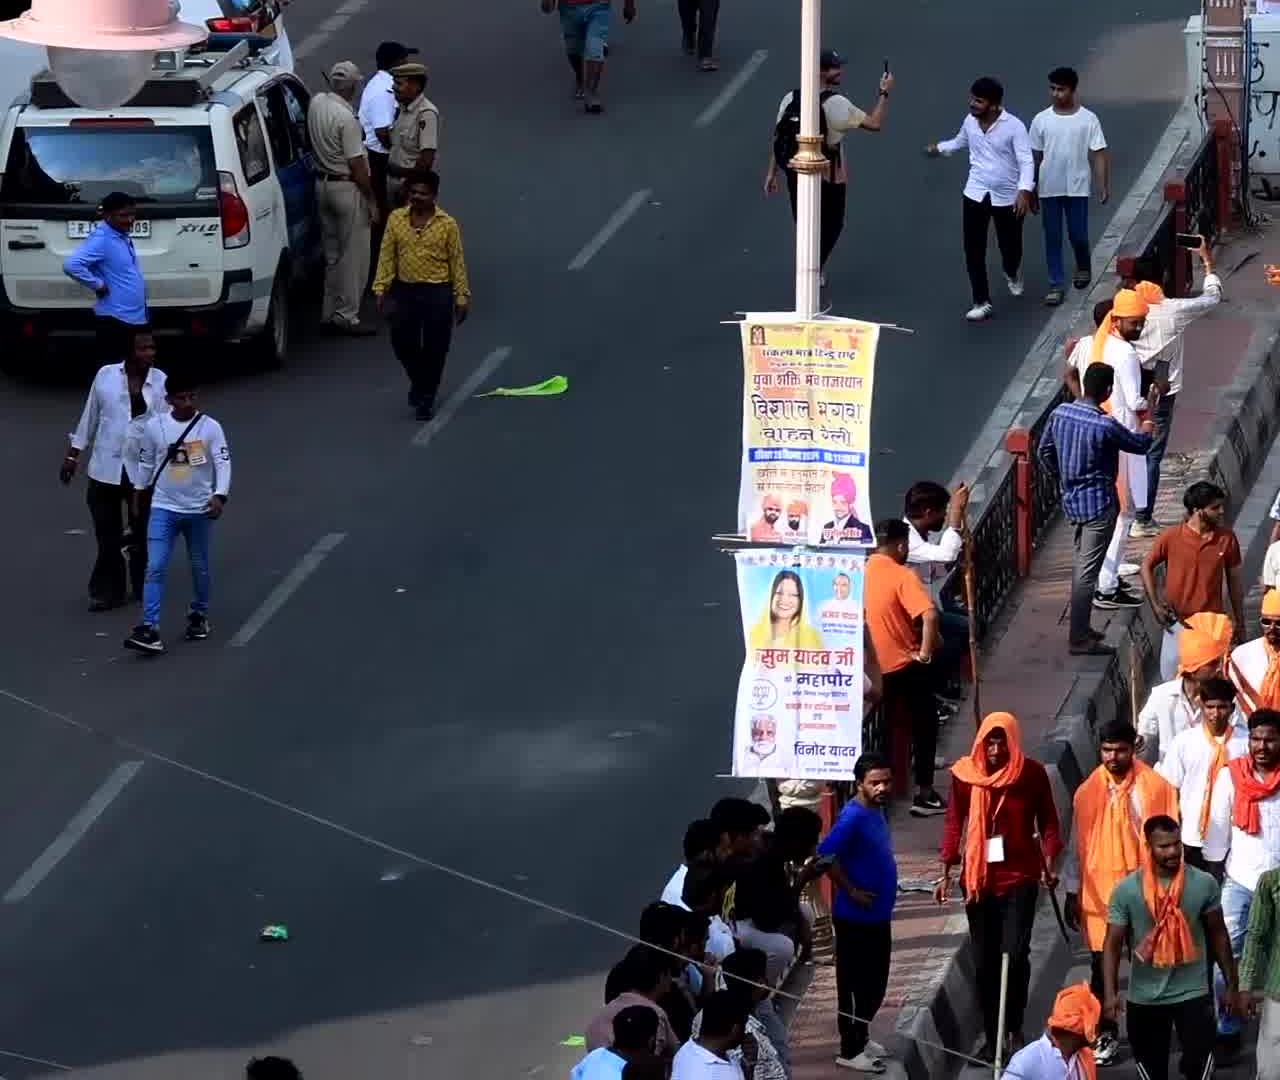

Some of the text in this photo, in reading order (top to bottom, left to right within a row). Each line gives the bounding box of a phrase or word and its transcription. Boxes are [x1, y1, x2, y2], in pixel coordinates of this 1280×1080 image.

[177, 223, 219, 235] XYLO
[793, 649, 832, 666] यादव
[834, 647, 855, 666] जी
[794, 741, 856, 757] विनोद यादव
